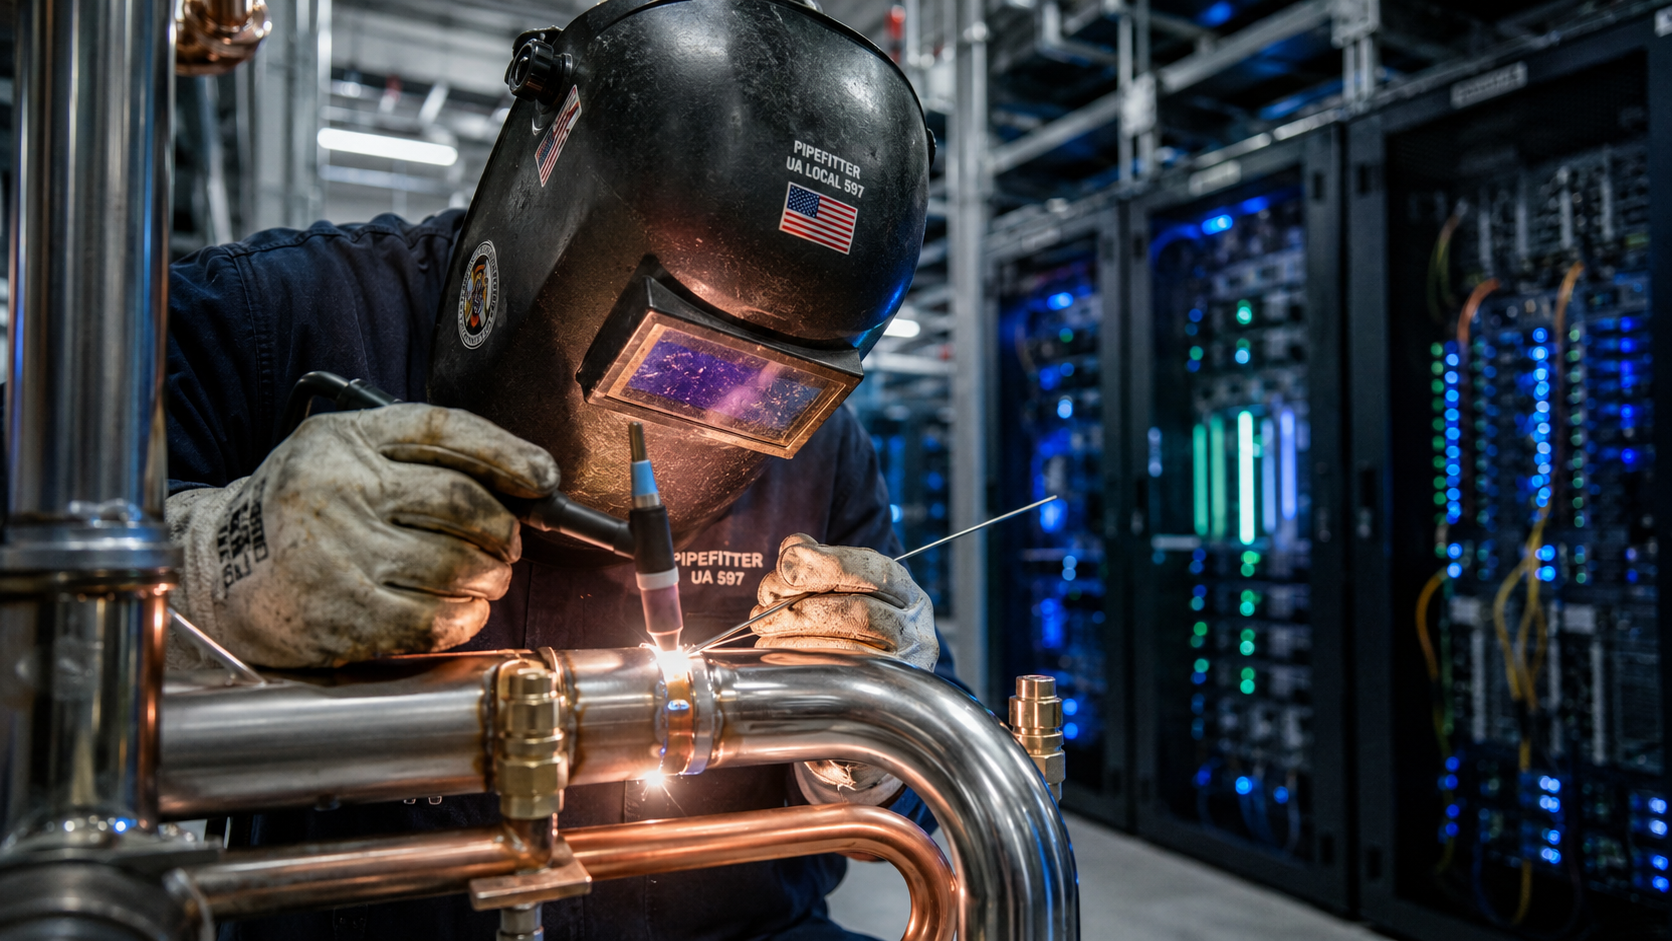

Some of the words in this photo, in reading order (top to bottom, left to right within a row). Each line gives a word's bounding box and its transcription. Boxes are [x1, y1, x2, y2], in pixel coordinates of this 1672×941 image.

[786, 156, 803, 174] UA
[805, 163, 842, 189] LOCAL
[844, 178, 865, 199] 597
[793, 140, 861, 179] PIPEFITTER
[691, 570, 714, 585] UA
[717, 570, 745, 586] 597
